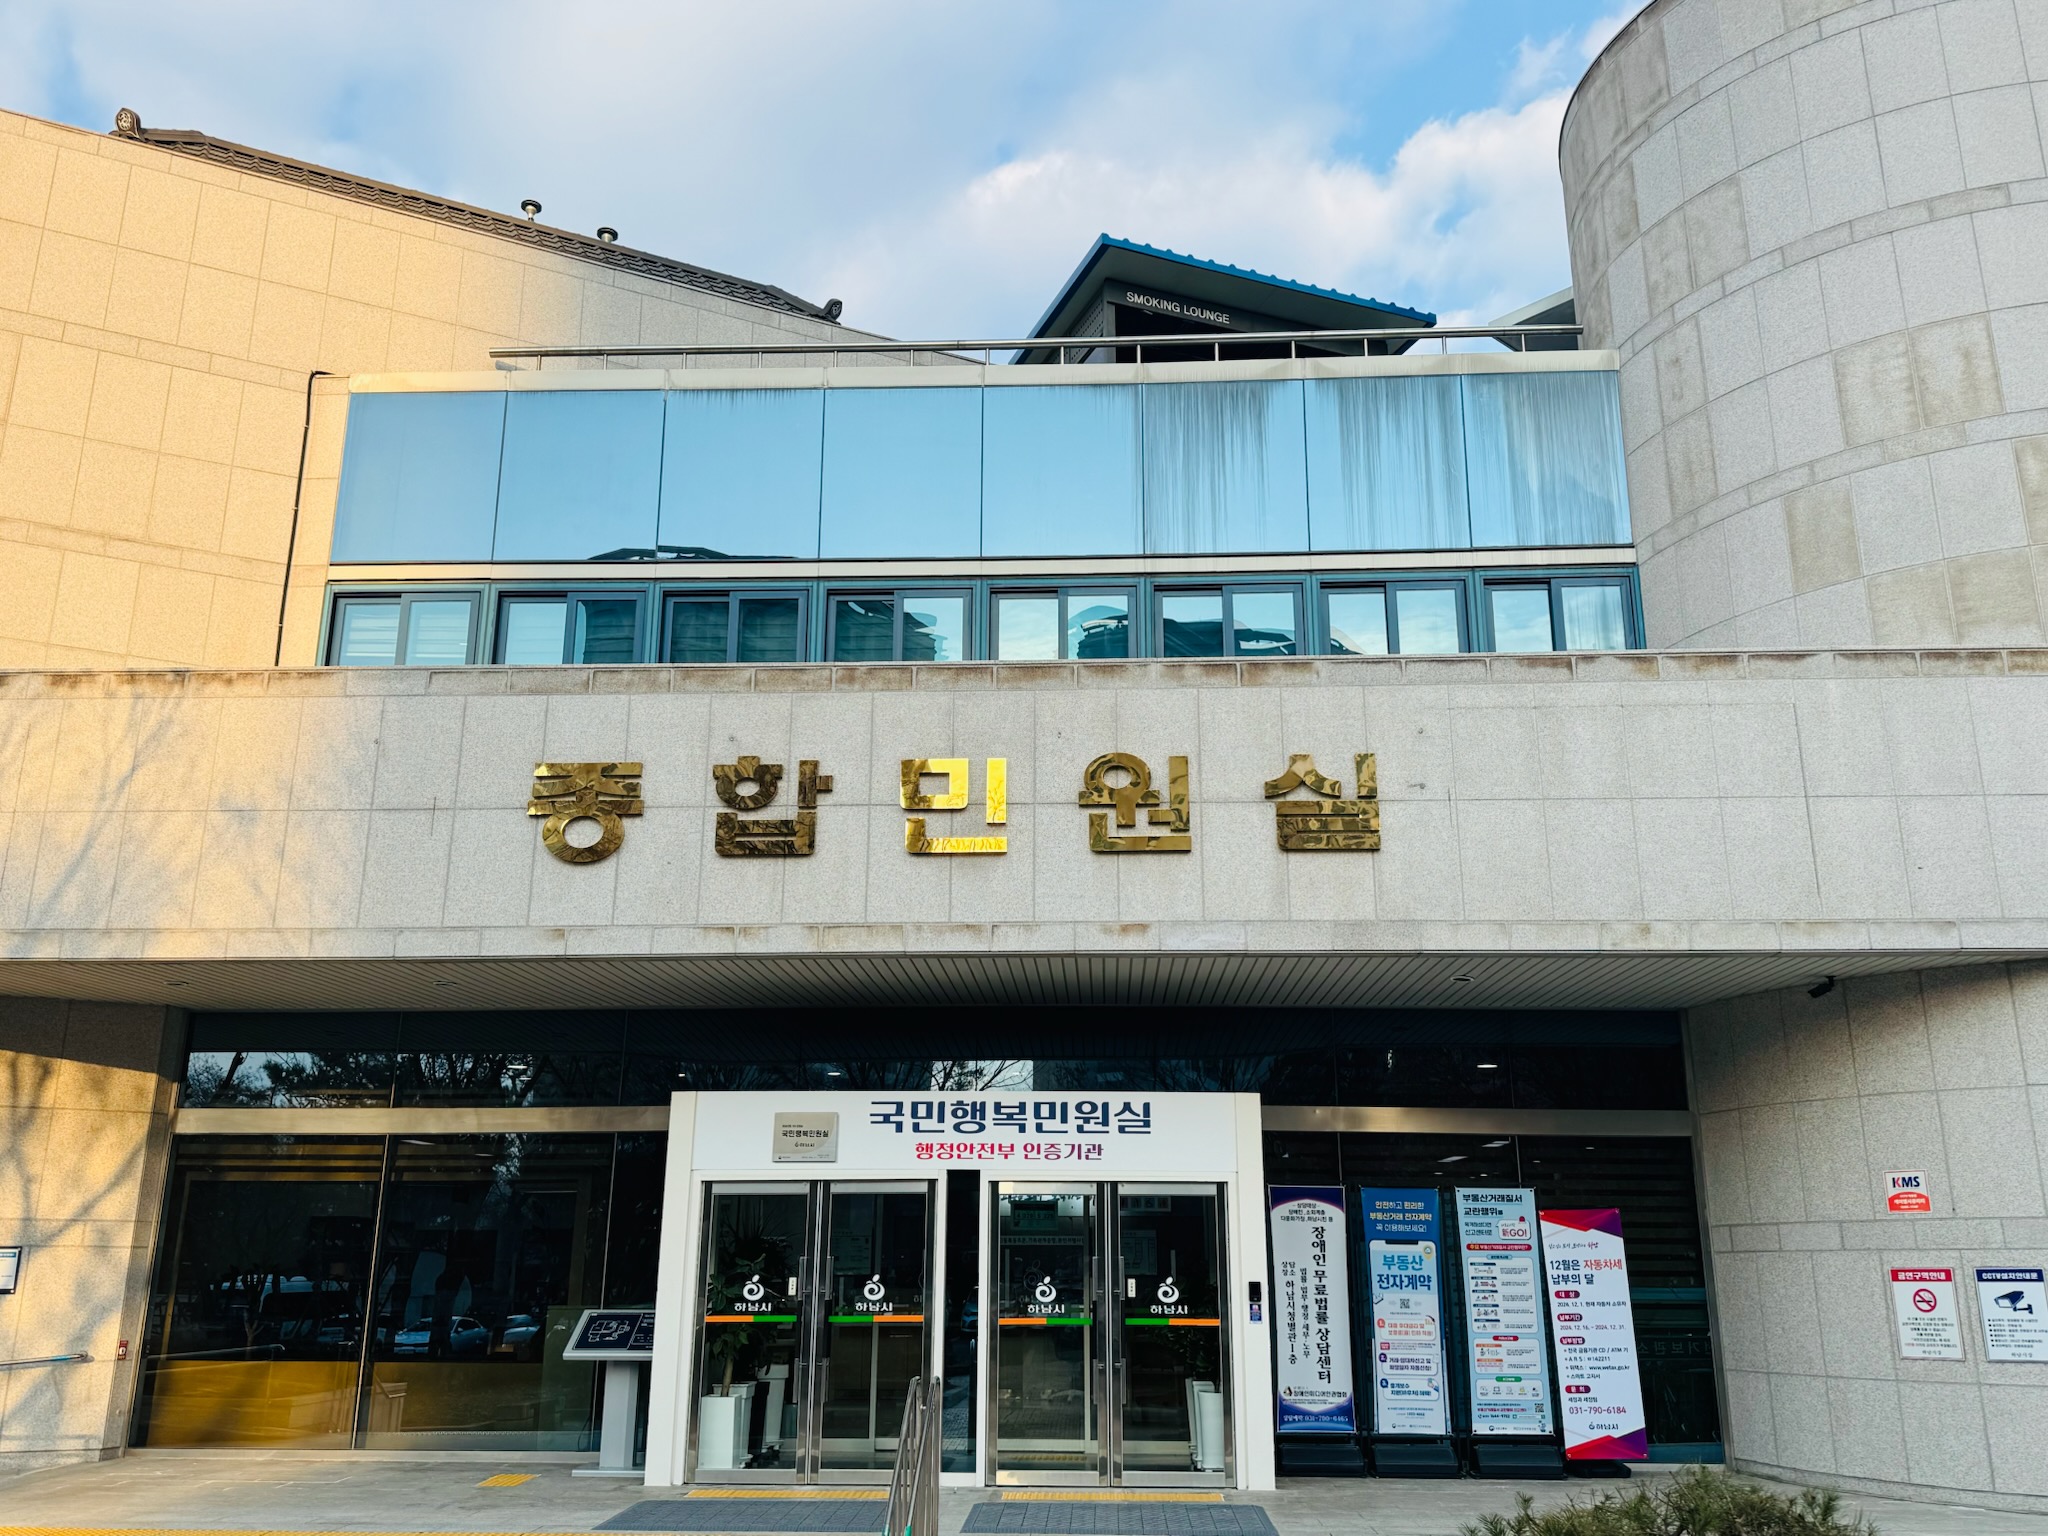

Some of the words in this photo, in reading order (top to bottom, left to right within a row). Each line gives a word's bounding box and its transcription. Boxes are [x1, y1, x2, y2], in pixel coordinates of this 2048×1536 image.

[1126, 291, 1180, 313] SMOKING
[1184, 305, 1230, 324] LOUNGE
[870, 1100, 1151, 1134] 국민행복민원실
[915, 1142, 1015, 1160] 행정안전부
[1023, 1143, 1104, 1160] 인증기관
[1892, 1176, 1920, 1188] KMS
[1462, 1194, 1523, 1203] 부동산거래질서
[1370, 1212, 1403, 1220] 부동산거래
[1405, 1213, 1432, 1221] 전자계약
[1464, 1208, 1503, 1216] 교란행위를
[1382, 1254, 1423, 1271] 부동산
[1550, 1260, 1580, 1271] 12월은
[1584, 1259, 1623, 1271] 자동차세
[1551, 1274, 1581, 1285] 납부의
[1584, 1274, 1594, 1285] 달
[1898, 1272, 1946, 1280] 금연구역안내
[1377, 1274, 1432, 1290] 전자계약
[734, 1302, 772, 1312] 하남시
[855, 1302, 893, 1312] 하남시
[1027, 1304, 1065, 1314] 하남시
[1150, 1305, 1188, 1314] 하남시
[1569, 1406, 1627, 1415] 031-790-6184
